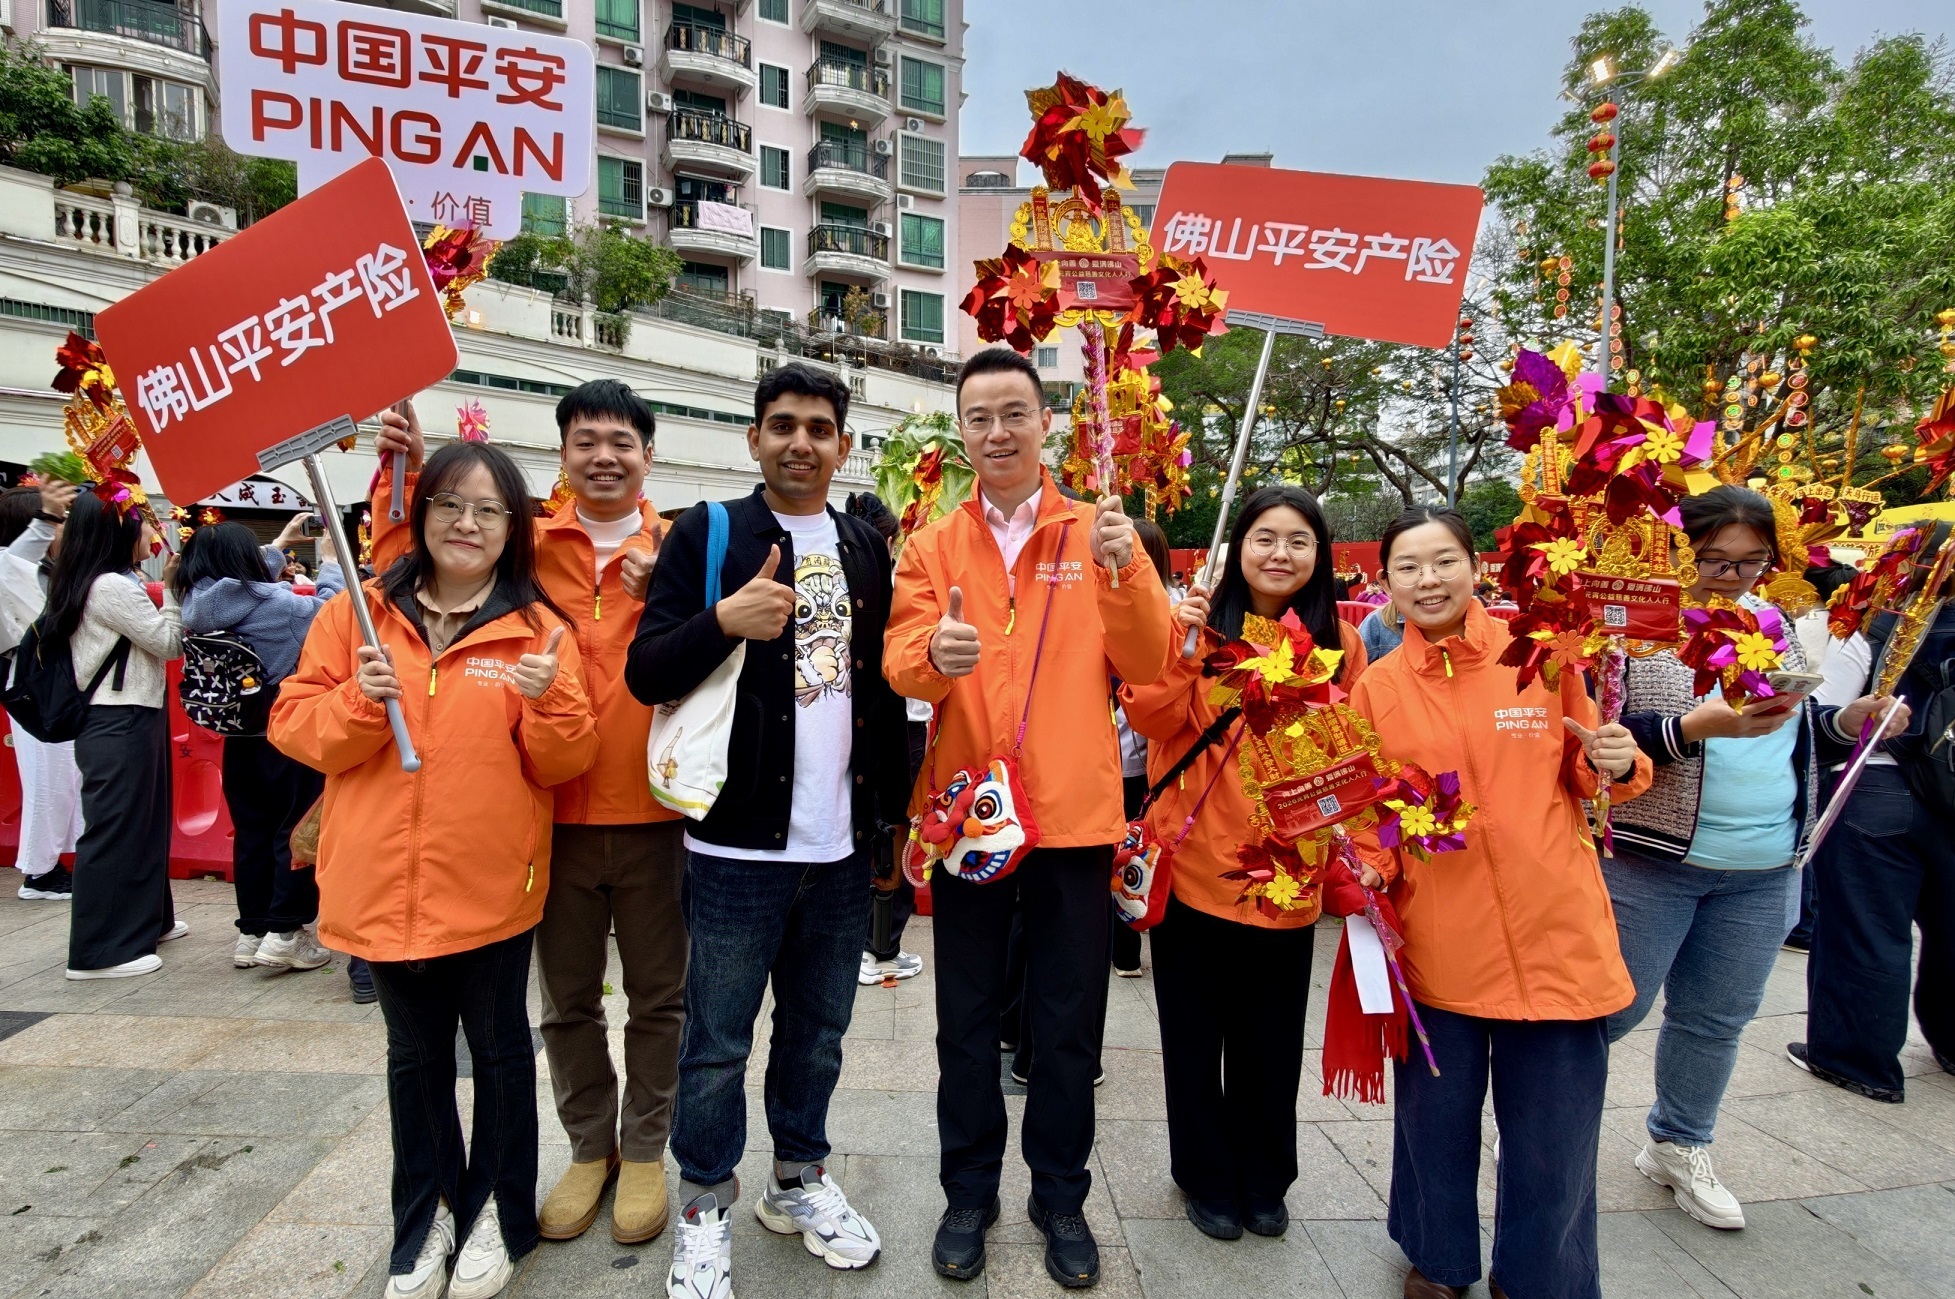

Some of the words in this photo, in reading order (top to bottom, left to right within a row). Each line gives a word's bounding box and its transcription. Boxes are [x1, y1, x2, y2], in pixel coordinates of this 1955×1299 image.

[249, 8, 566, 112] 中国平安
[431, 190, 492, 227] 价值
[1163, 211, 1461, 285] 佛山平安产险
[136, 242, 420, 434] 佛山平安产险
[1035, 561, 1083, 572] 中国平安
[466, 656, 517, 675] 中国平安
[1494, 707, 1548, 720] 中国平安
